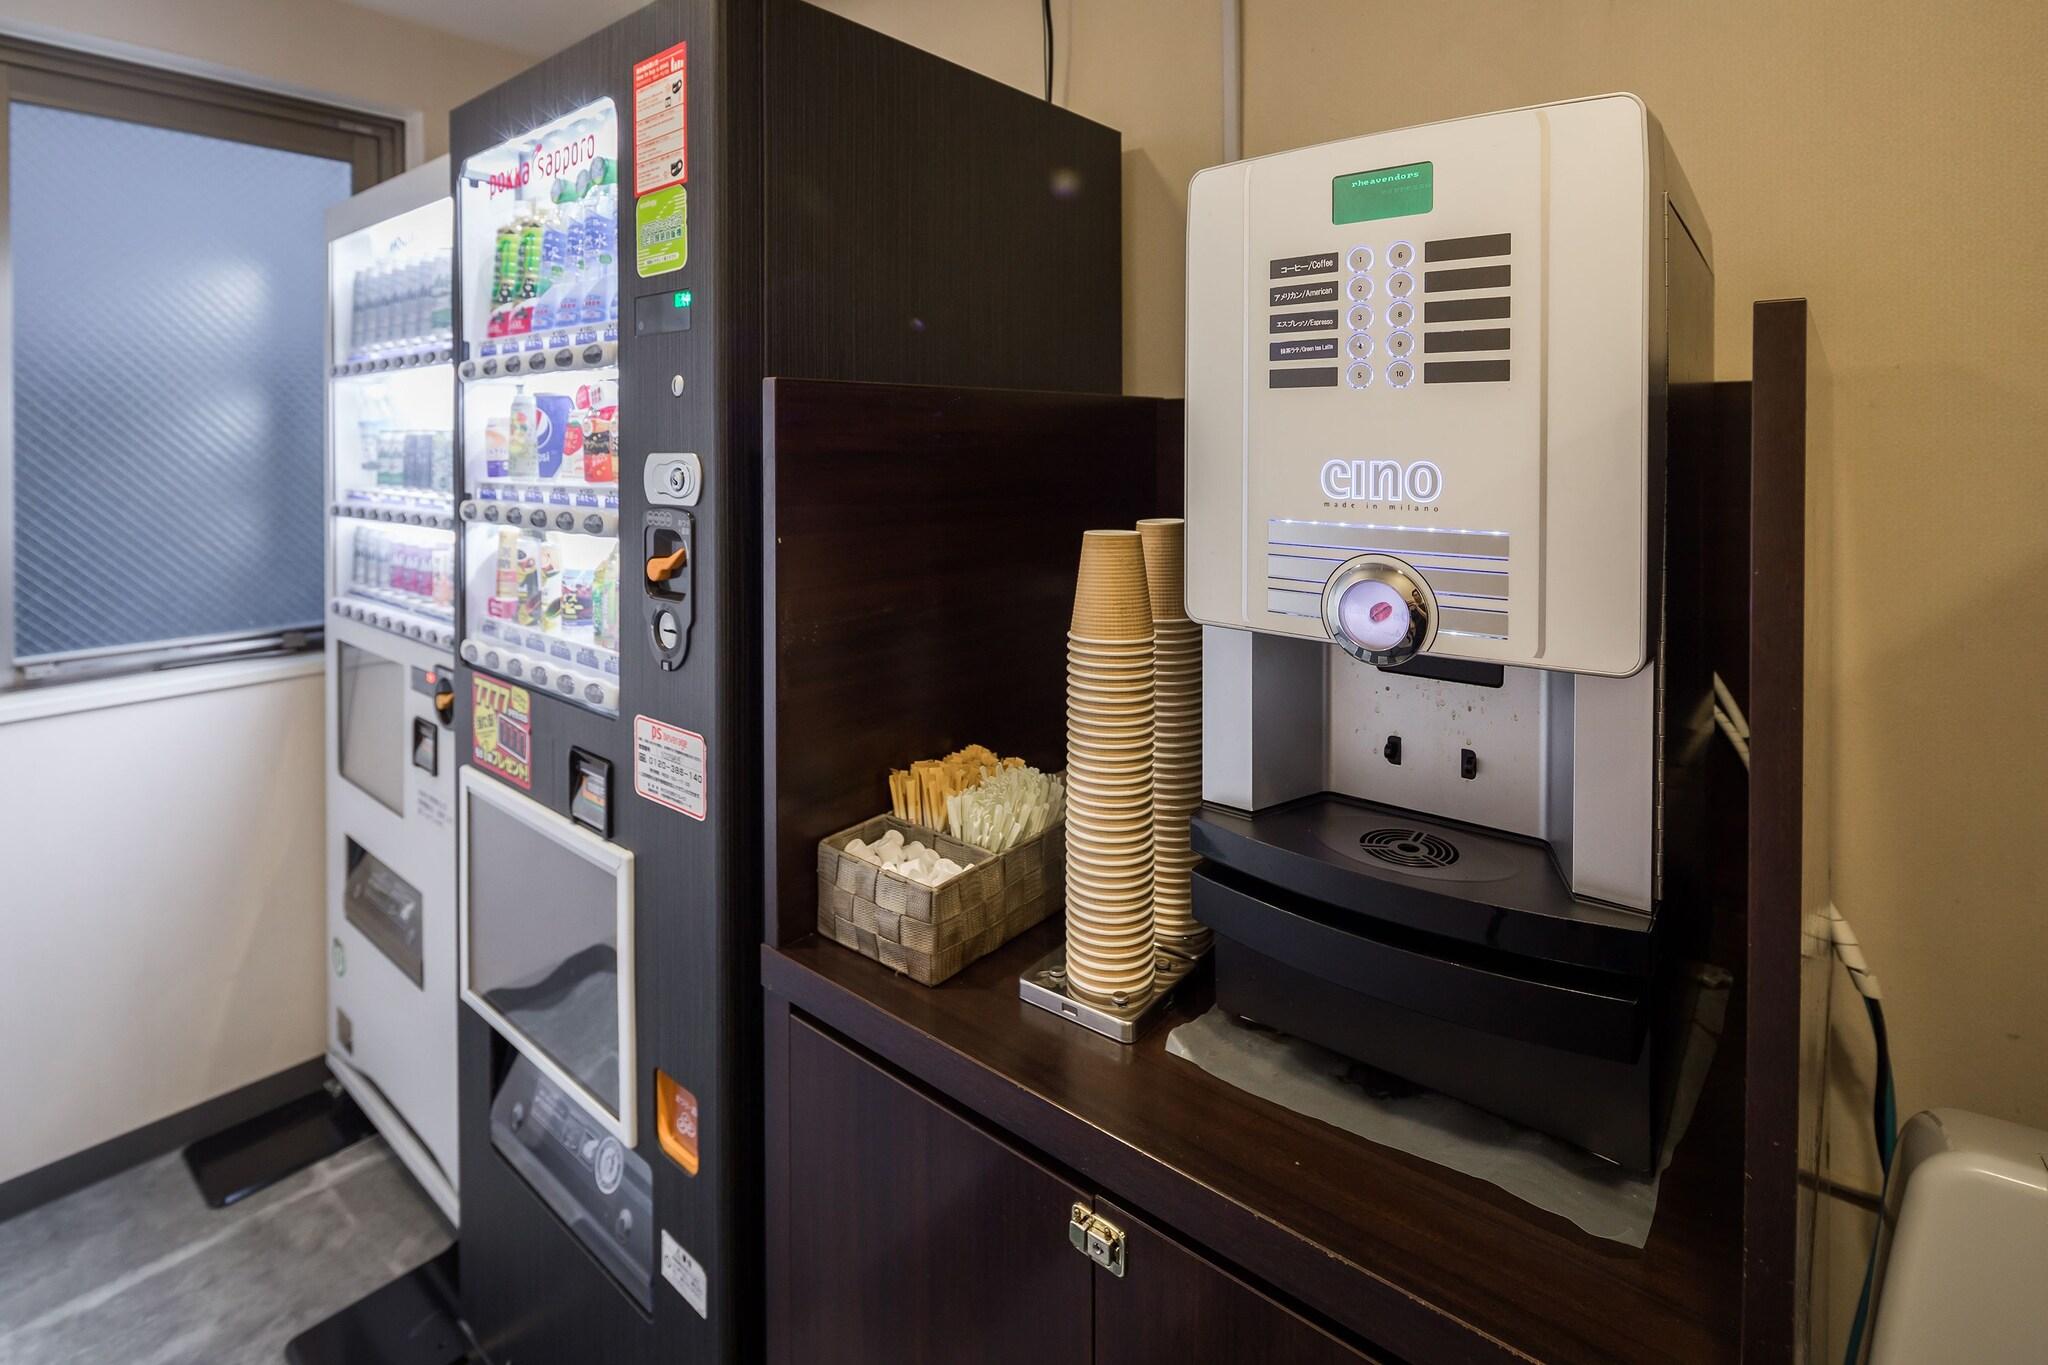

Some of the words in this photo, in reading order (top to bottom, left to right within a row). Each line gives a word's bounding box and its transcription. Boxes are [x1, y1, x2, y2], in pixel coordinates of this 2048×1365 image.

[537, 134, 596, 178] sapporo
[1351, 171, 1420, 188] rheavendors
[1280, 259, 1334, 274] コーヒー/Coffee
[1274, 287, 1333, 302] アメリカン/American
[1320, 458, 1443, 503] cino
[1323, 501, 1356, 509] made
[1366, 502, 1378, 510] in
[1389, 503, 1439, 512] milano
